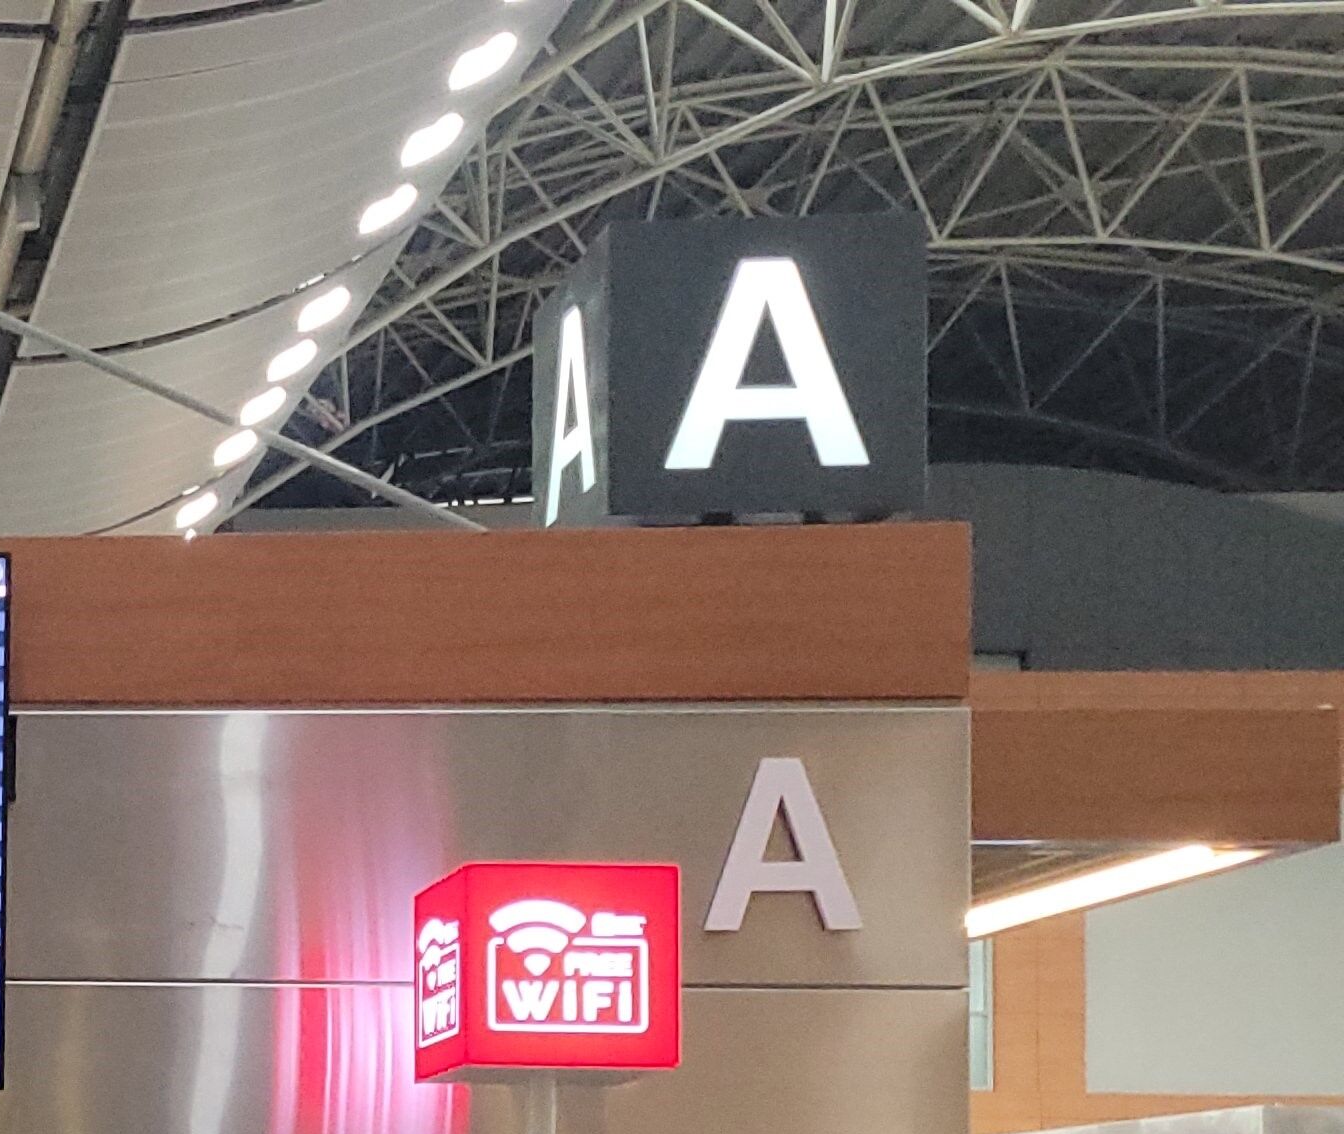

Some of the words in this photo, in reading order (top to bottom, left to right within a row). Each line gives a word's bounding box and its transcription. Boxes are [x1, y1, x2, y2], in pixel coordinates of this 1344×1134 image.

[547, 307, 595, 527] A
[665, 257, 870, 470] A
[705, 757, 862, 933] A
